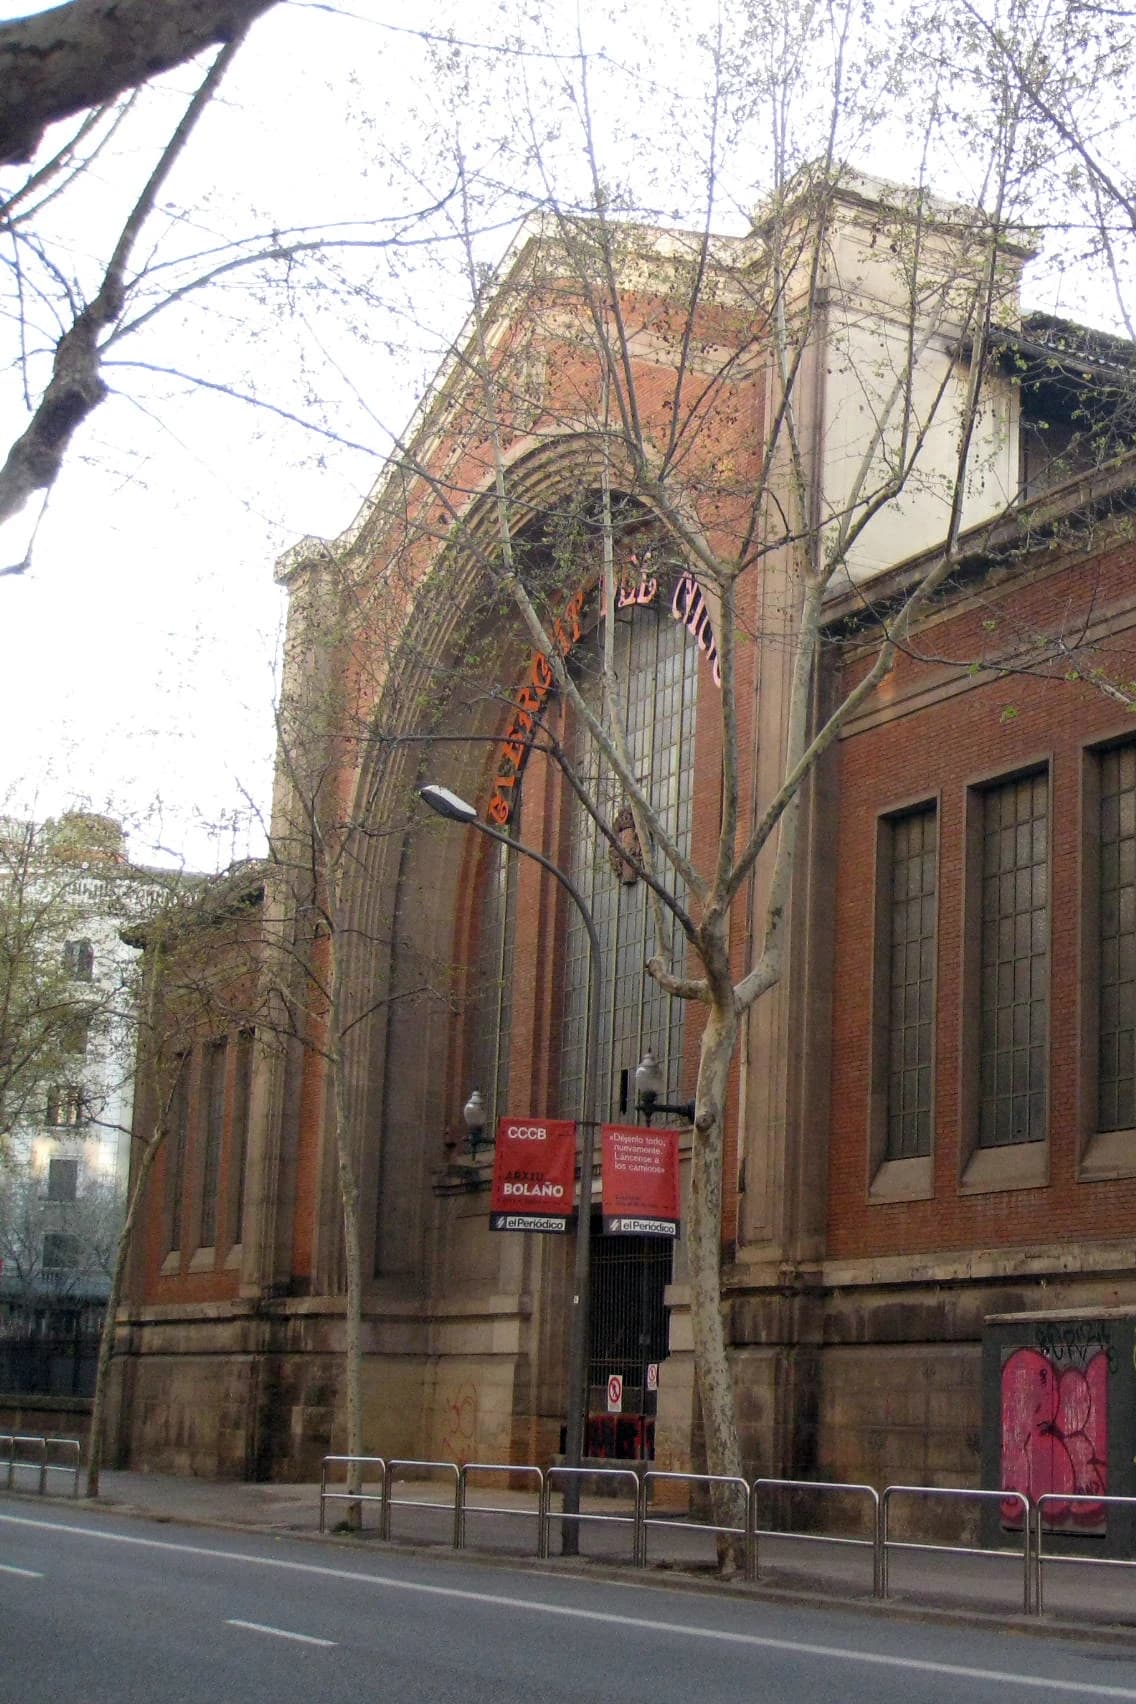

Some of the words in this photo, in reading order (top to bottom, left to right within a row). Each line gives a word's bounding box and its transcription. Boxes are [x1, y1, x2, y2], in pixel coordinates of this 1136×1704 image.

[508, 1126, 546, 1140] CCCB
[614, 1161, 626, 1170] los
[505, 1170, 545, 1181] ARXIU
[503, 1182, 564, 1197] BOLAÑO
